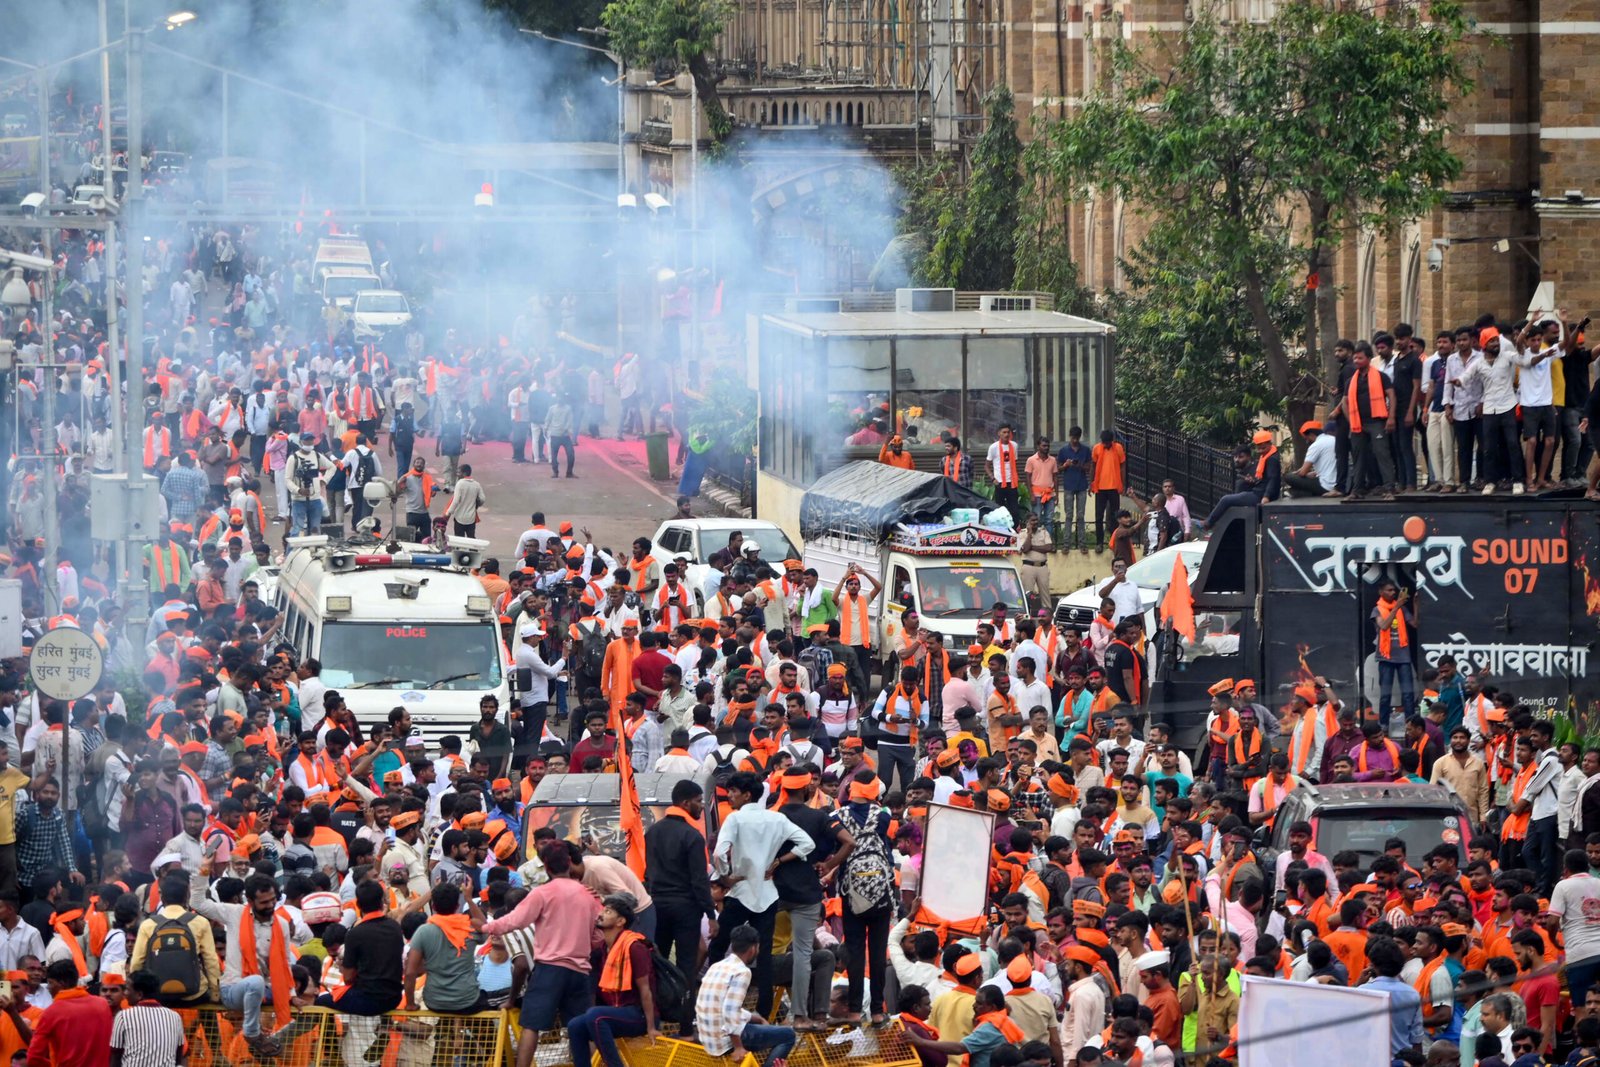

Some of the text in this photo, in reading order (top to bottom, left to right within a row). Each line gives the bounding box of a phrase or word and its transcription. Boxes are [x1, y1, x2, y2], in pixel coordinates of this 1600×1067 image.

[1472, 538, 1568, 565] SOUND
[1504, 568, 1539, 594] 07
[386, 627, 427, 638] POLICE
[37, 643, 63, 658] हरित
[36, 662, 92, 681] सुंदर मुंबई
